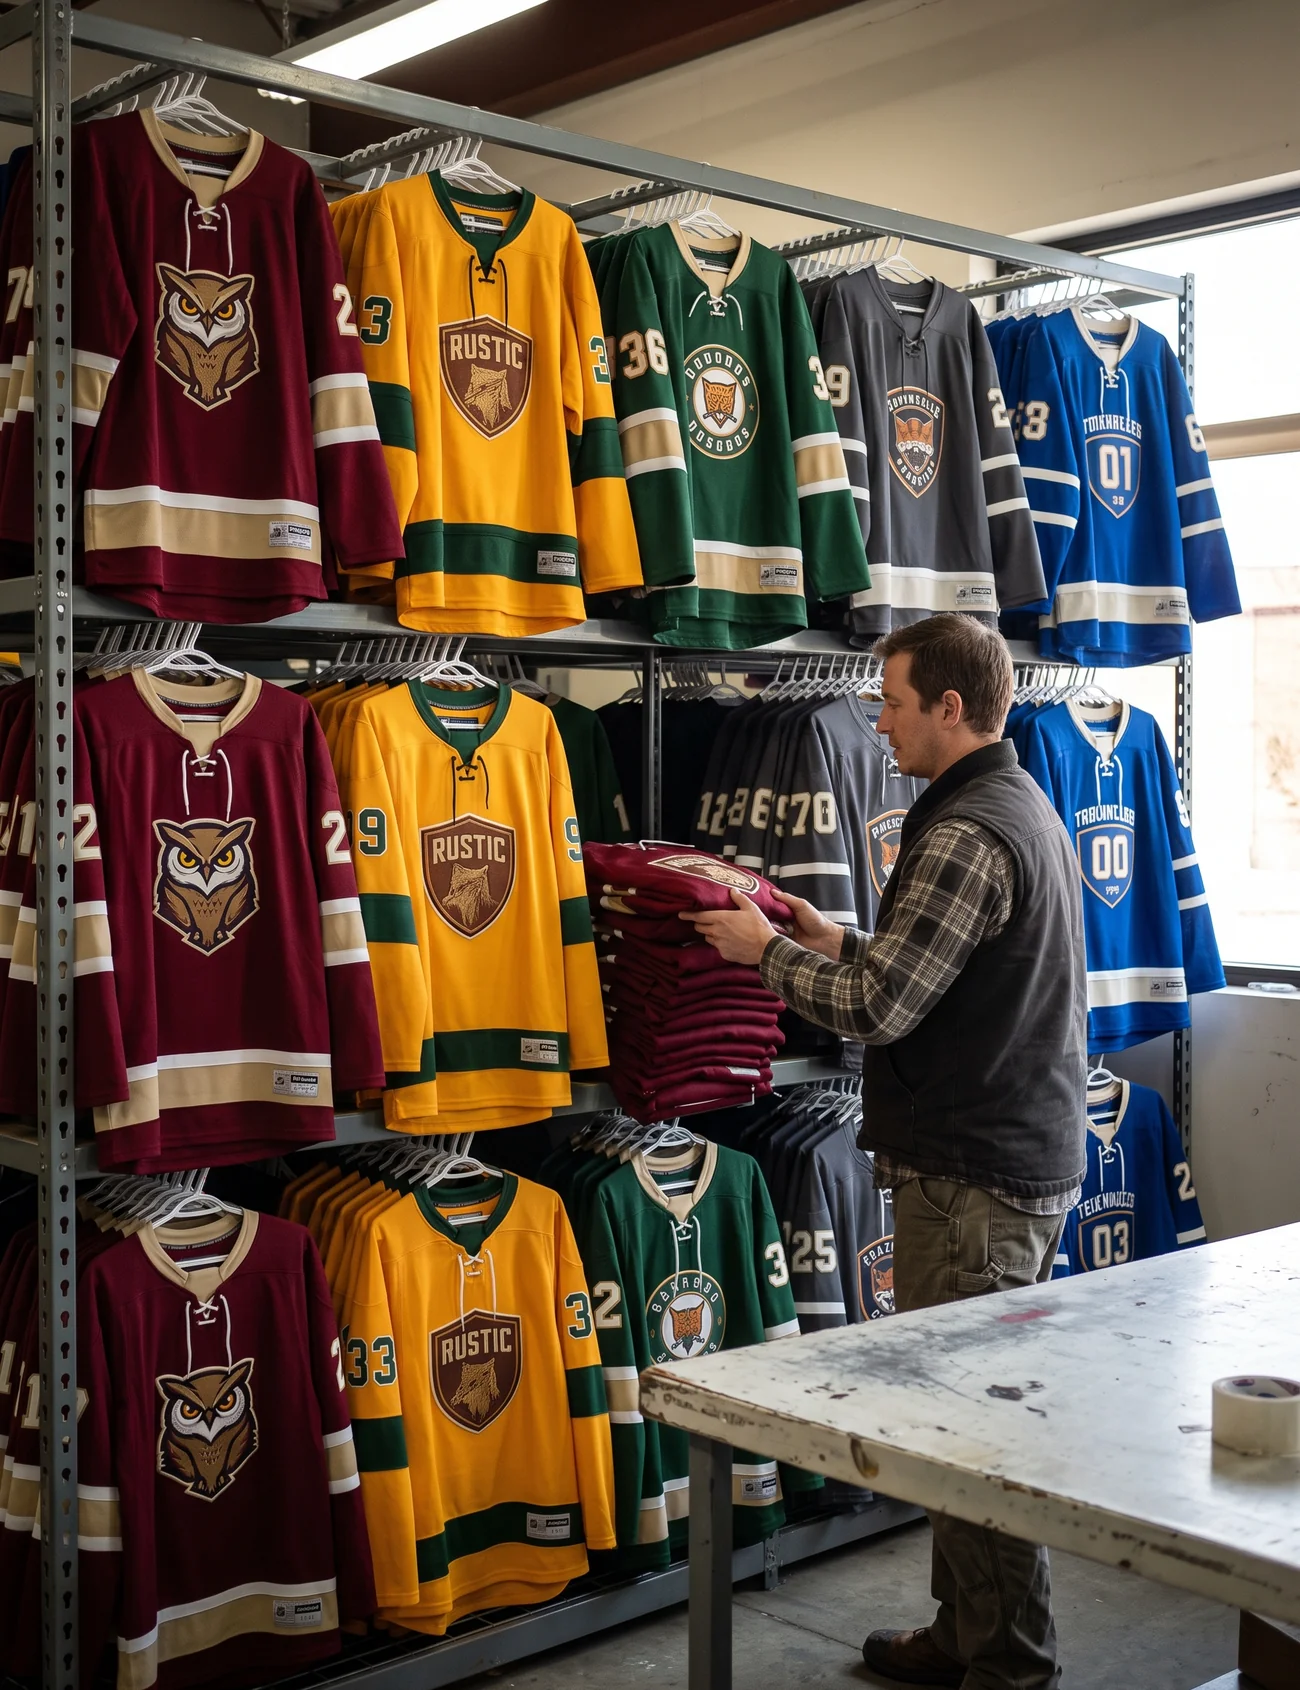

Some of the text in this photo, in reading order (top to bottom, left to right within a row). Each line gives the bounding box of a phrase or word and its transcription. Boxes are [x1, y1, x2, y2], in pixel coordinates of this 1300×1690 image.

[332, 283, 359, 336] 2
[359, 295, 393, 346] 3
[450, 334, 523, 370] RUSTIC
[825, 365, 850, 408] 9
[988, 388, 1011, 428] 2
[1099, 444, 1132, 491] 01
[73, 803, 102, 862] 2
[322, 811, 351, 865] 2
[358, 808, 387, 856] 9
[432, 834, 506, 865] RUSTIC
[1092, 834, 1128, 881] 00
[1173, 1161, 1196, 1202] 2
[764, 1241, 790, 1288] 3
[792, 1230, 837, 1273] 25
[1092, 1220, 1129, 1268] 03
[565, 1291, 593, 1339] 3
[593, 1281, 622, 1329] 2
[347, 1335, 398, 1387] 33
[441, 1327, 512, 1366] RUSTIC
